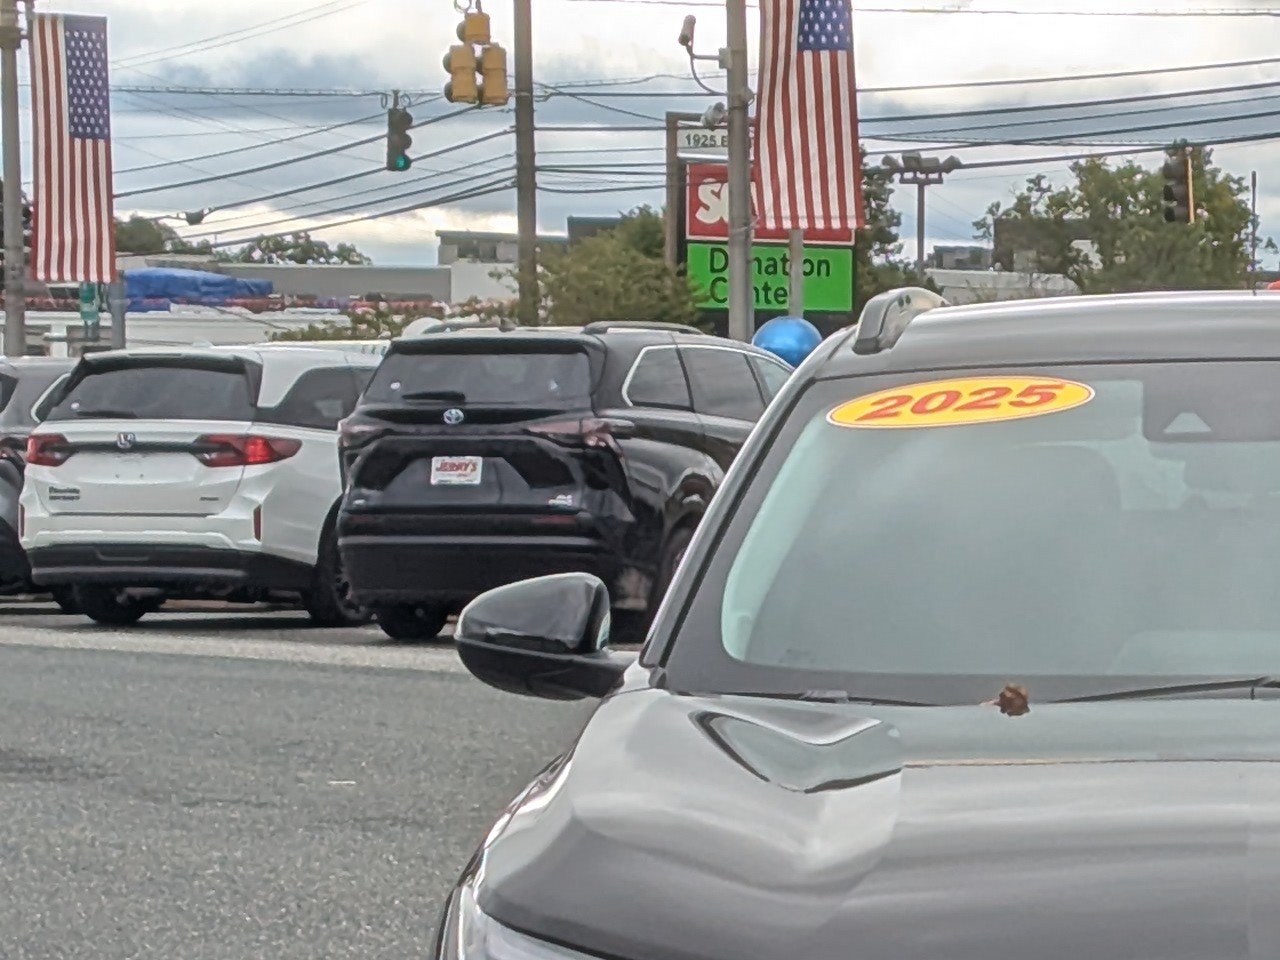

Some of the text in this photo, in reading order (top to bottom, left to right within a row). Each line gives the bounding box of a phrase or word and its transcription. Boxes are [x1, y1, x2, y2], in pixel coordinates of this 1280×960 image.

[709, 247, 831, 278] Dnaton
[709, 276, 788, 306] Cnte
[854, 384, 1066, 422] 2025
